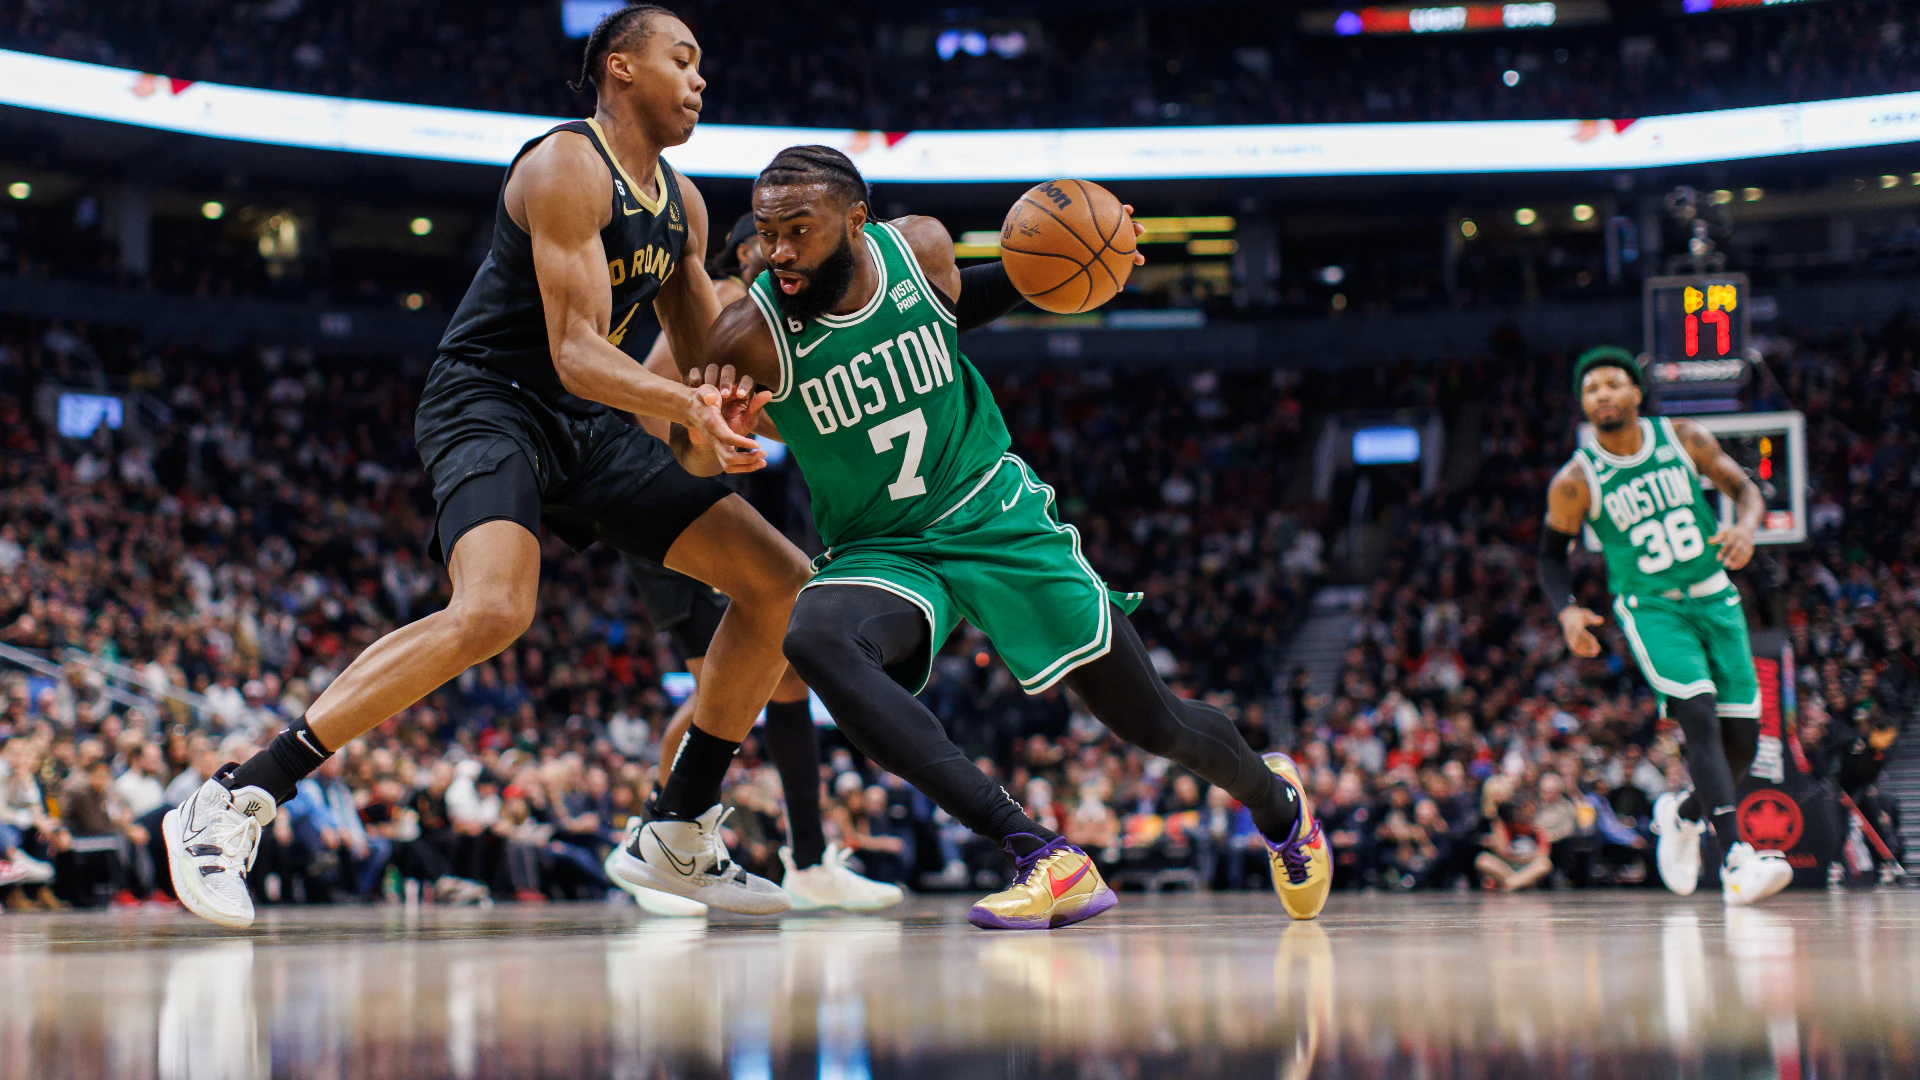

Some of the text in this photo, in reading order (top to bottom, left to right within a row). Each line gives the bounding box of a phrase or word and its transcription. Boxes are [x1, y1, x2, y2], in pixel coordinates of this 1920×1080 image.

[614, 179, 626, 197] 6
[608, 244, 675, 287] ORON
[889, 278, 917, 304] VISTA
[896, 291, 923, 314] PRINT
[787, 316, 803, 333] 6
[1685, 310, 1730, 357] 17
[799, 321, 954, 435] BOSTON
[867, 407, 928, 502] 7
[1603, 465, 1695, 532] BOSTON
[1629, 507, 1705, 574] 36
